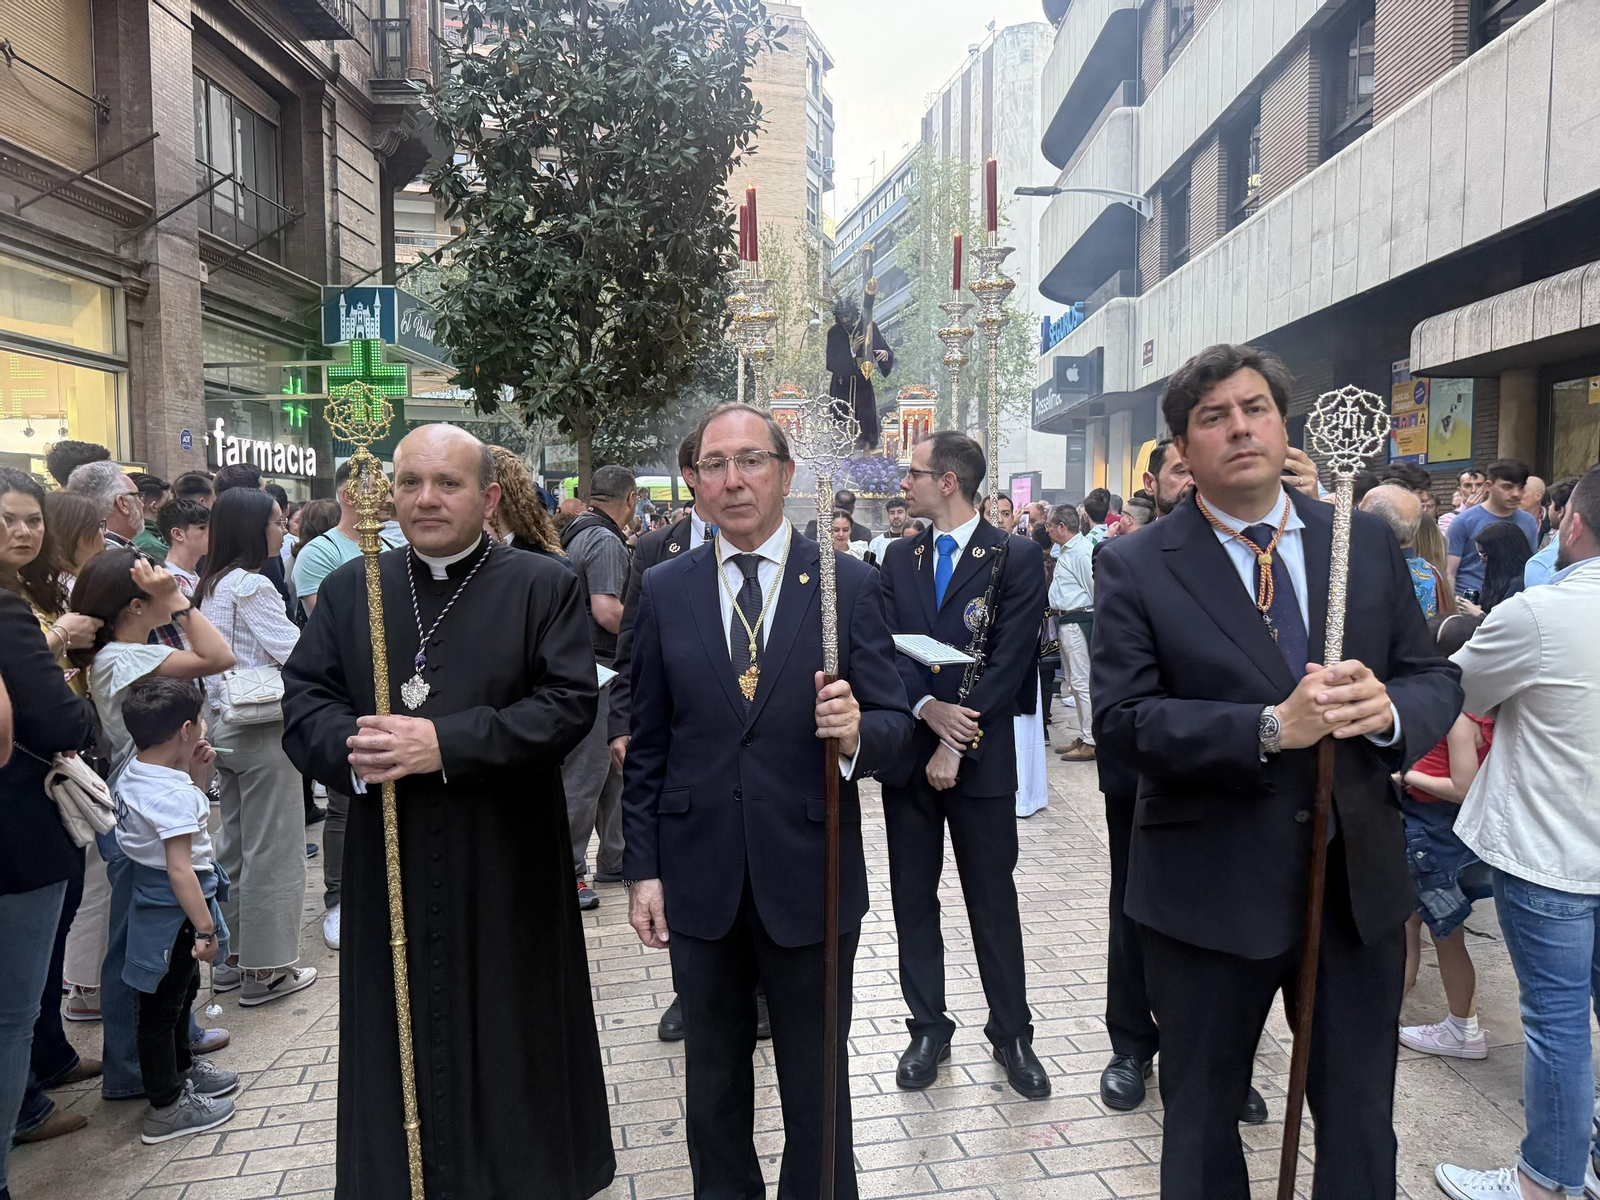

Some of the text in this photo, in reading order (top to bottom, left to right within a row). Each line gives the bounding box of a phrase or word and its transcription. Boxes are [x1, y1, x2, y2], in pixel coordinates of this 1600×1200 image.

[400, 313, 436, 341] El Palac
[213, 417, 317, 477] farmacia
